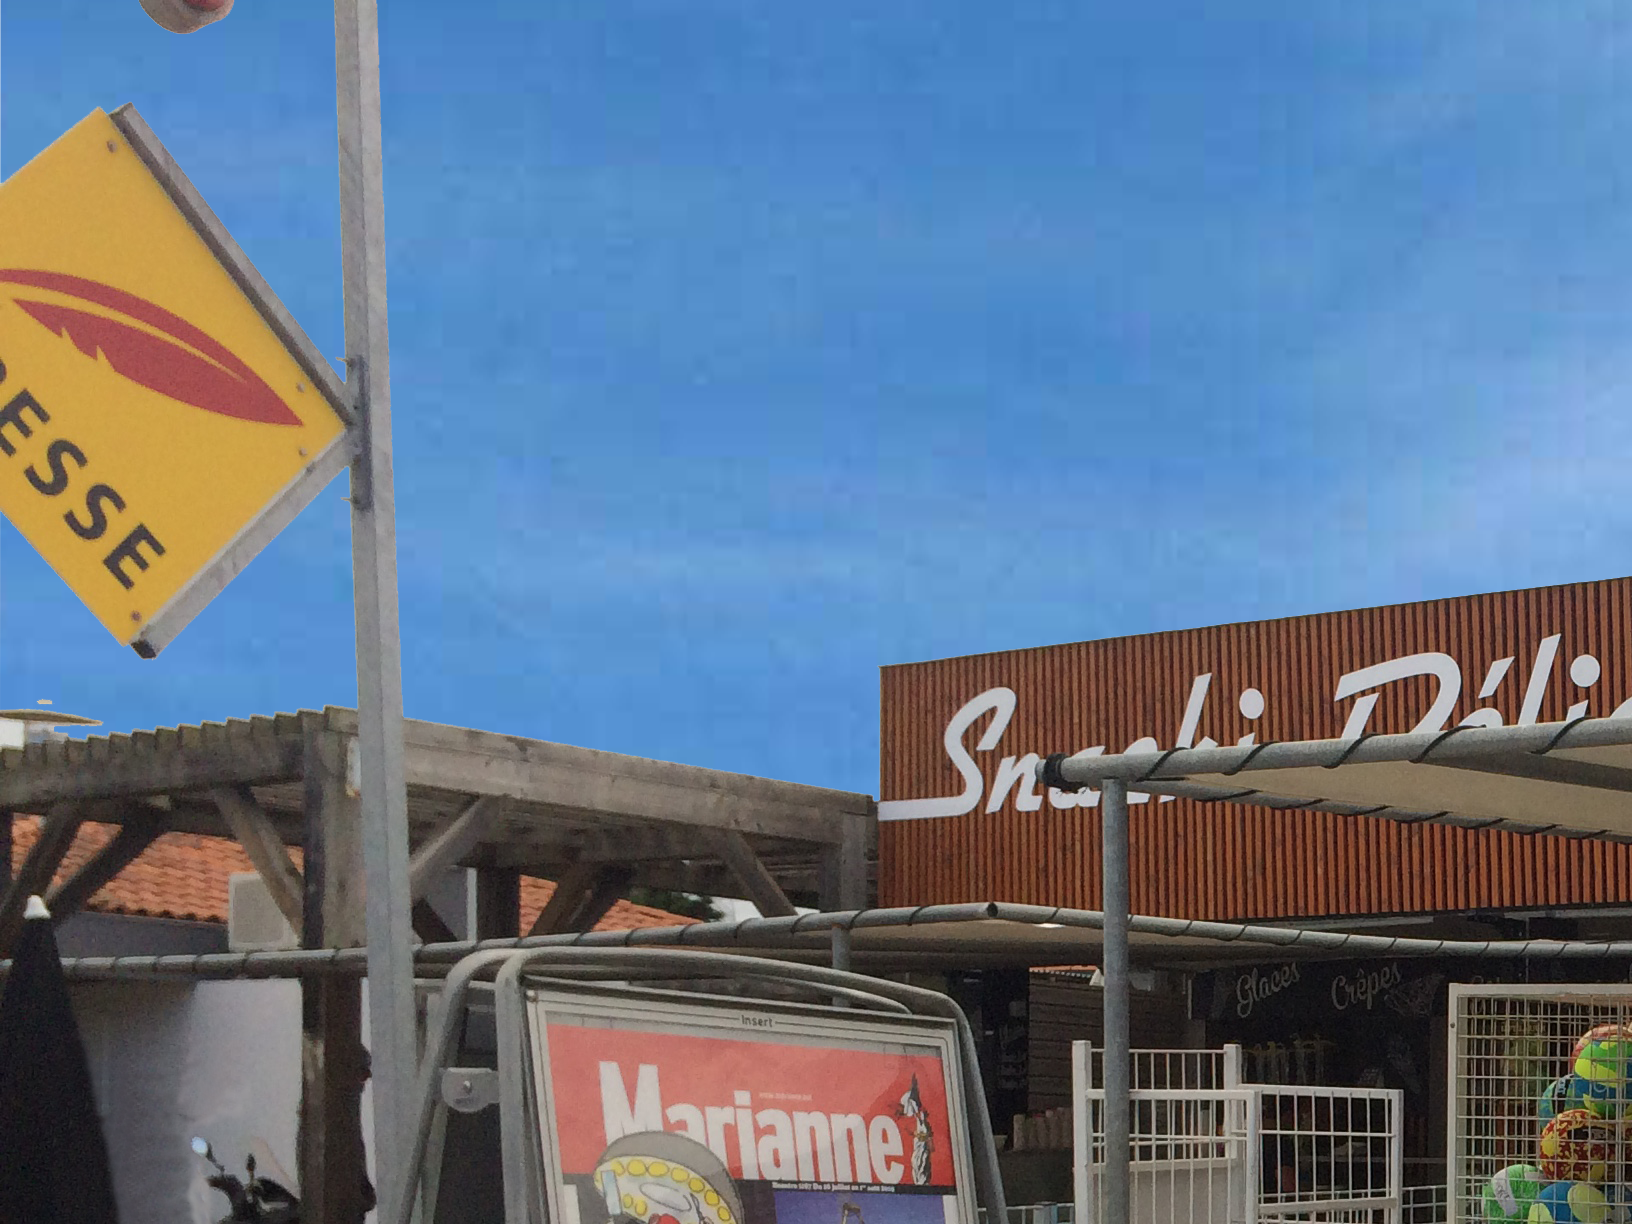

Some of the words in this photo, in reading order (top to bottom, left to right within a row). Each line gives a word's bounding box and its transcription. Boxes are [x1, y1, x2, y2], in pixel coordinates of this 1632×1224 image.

[0, 358, 165, 590] ESSE
[1236, 961, 1301, 1018] Glaces
[1331, 961, 1401, 1011] Crêpes
[741, 1015, 773, 1028] Insert
